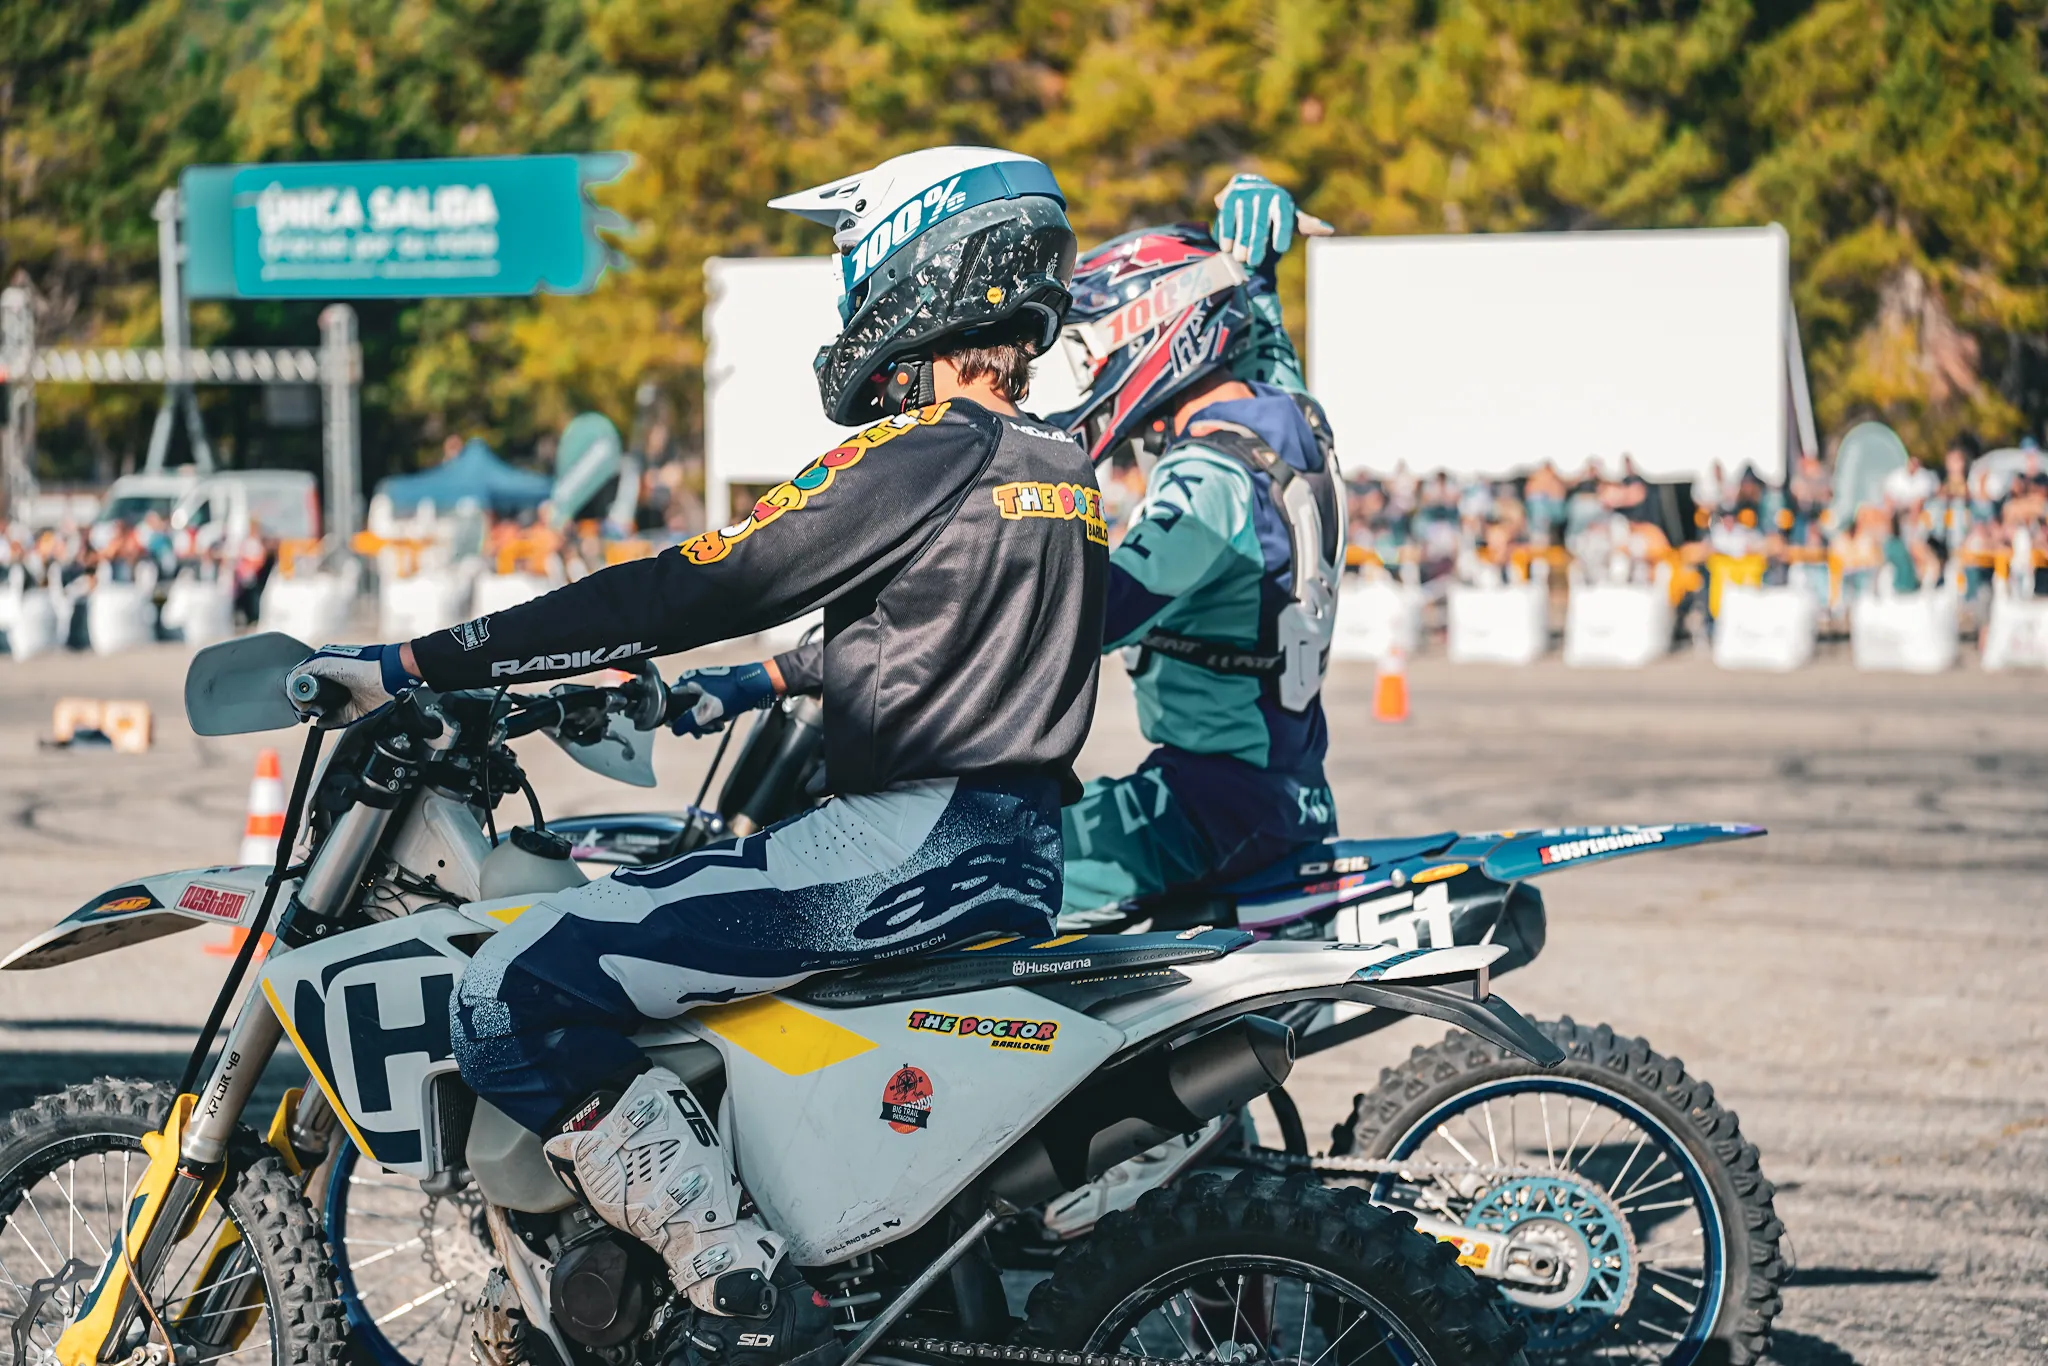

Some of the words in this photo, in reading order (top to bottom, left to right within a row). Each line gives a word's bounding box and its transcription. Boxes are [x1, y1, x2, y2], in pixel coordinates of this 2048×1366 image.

[368, 184, 498, 230] SALIDA
[852, 176, 967, 283] 100%
[1107, 265, 1213, 345] 100%
[998, 486, 1054, 514] THE
[492, 641, 658, 678] RADIKAL
[1071, 766, 1172, 857] FOX
[1336, 882, 1454, 949] 151
[874, 933, 947, 961] SUPERTECH
[1025, 958, 1091, 975] Husqvarna
[908, 1011, 959, 1034] THE
[958, 1017, 1057, 1042] DOCTOR
[991, 1040, 1050, 1052] BARILOCHE
[205, 1074, 232, 1119] XPLOR
[225, 1051, 241, 1070] 48
[892, 1105, 902, 1114] BIG
[903, 1108, 919, 1118] TRAIL
[892, 1113, 916, 1124] PATAGONIA
[825, 1243, 846, 1255] PULL
[845, 1236, 861, 1247] AND
[861, 1226, 881, 1240] SLIDE
